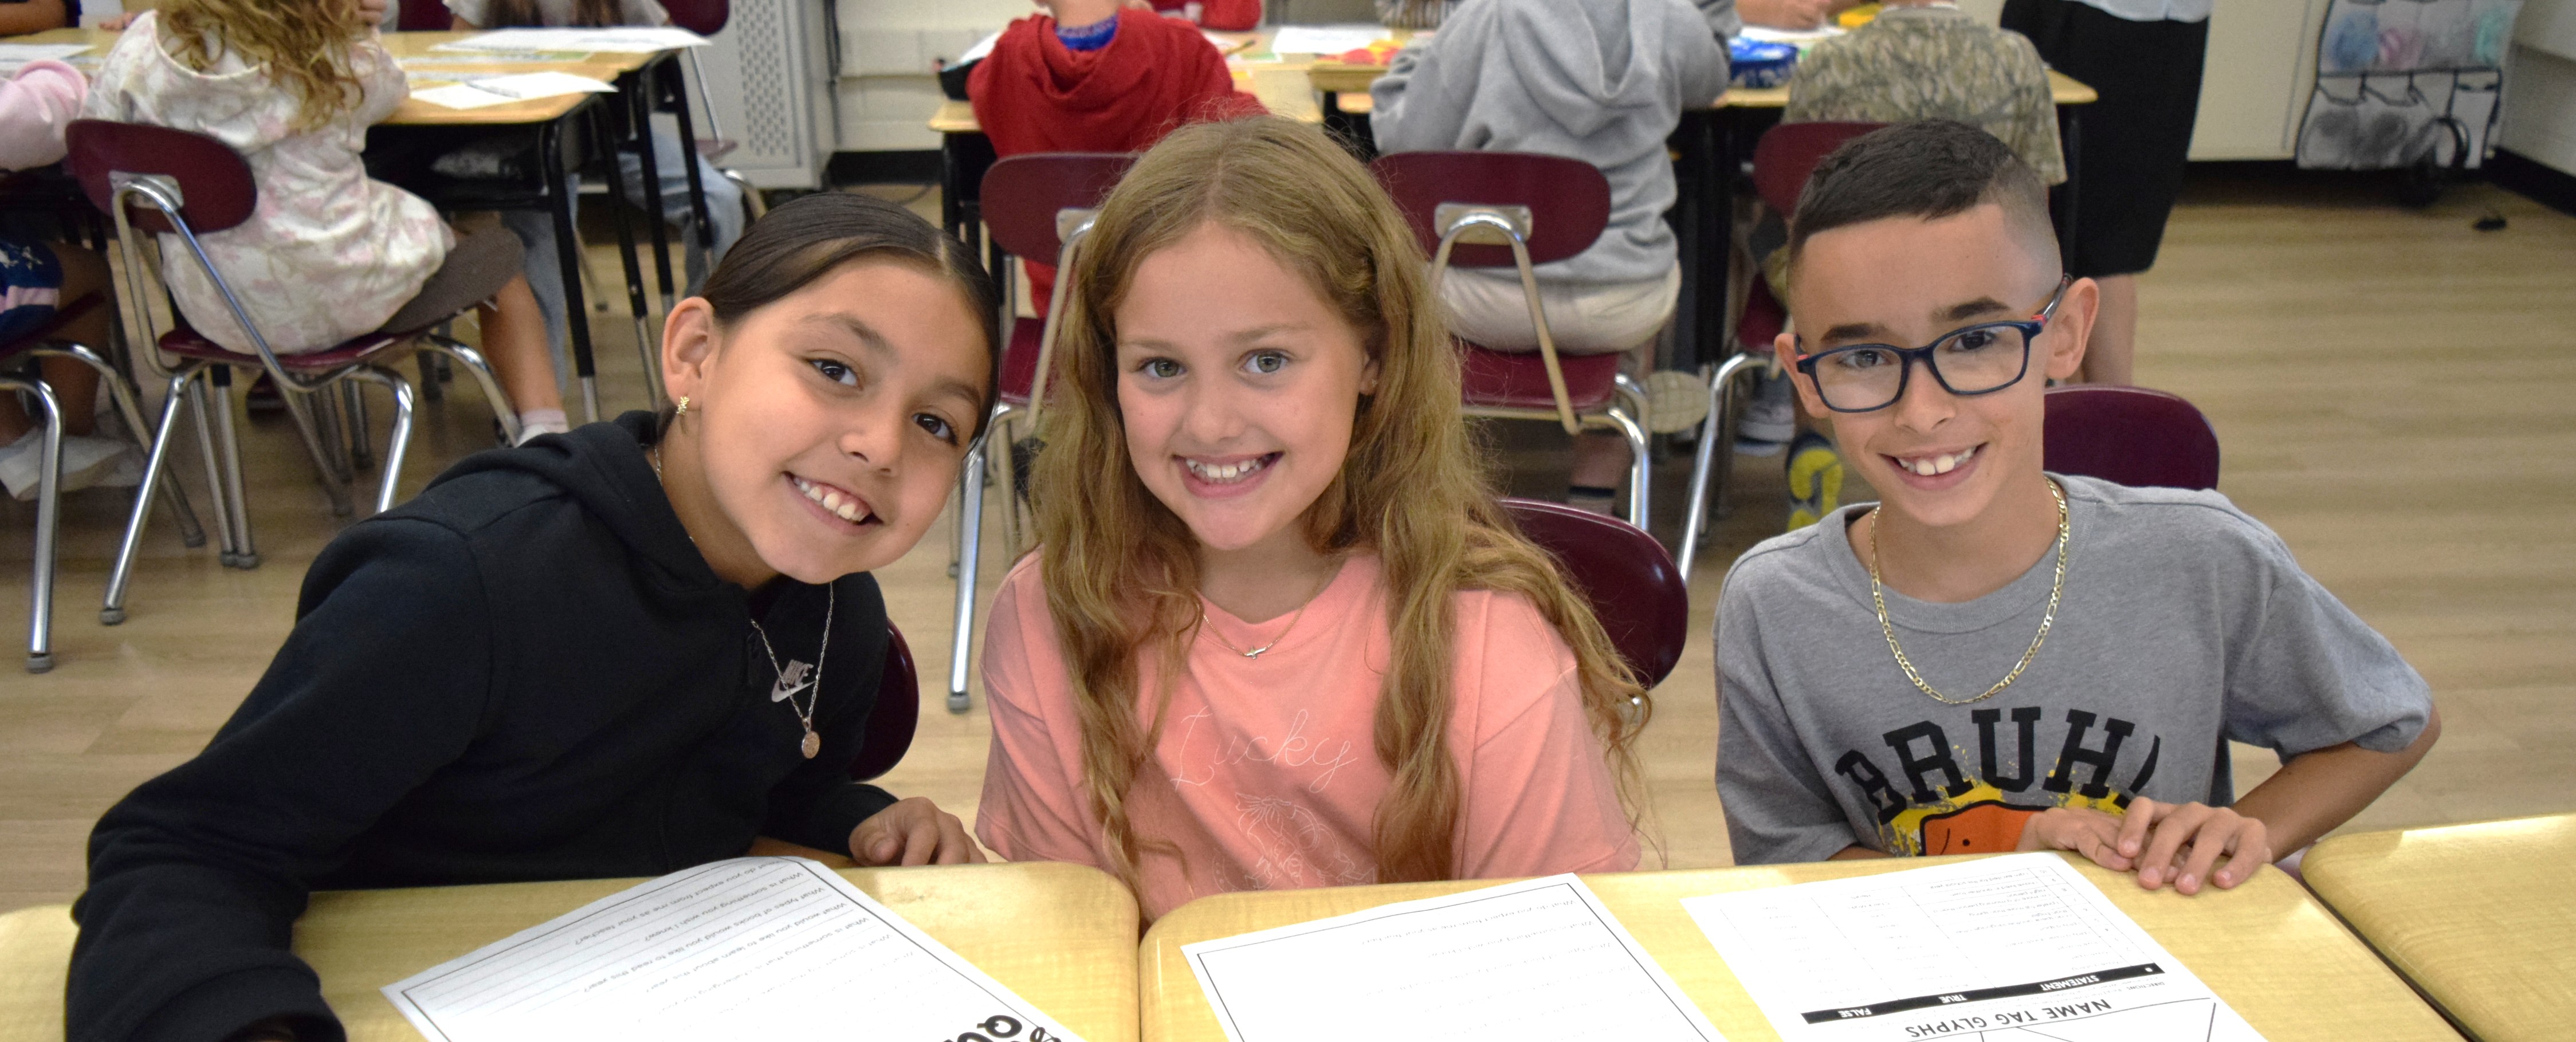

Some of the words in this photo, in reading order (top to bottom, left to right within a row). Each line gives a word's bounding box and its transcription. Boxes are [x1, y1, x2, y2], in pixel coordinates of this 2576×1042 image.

[1169, 705, 1358, 793] Lucky
[1835, 706, 2161, 824] BRUH!
[726, 872, 741, 883] you
[779, 872, 803, 884] What
[695, 880, 725, 896] expect
[800, 887, 825, 900] What
[670, 894, 693, 906] from
[720, 886, 767, 909] something
[774, 897, 799, 910] types
[639, 910, 650, 918] as
[653, 903, 669, 913] me
[702, 905, 718, 916] you
[823, 902, 847, 915] What
[618, 914, 637, 927] your
[680, 914, 700, 929] wish
[733, 911, 762, 927] books
[794, 912, 820, 927] would
[846, 917, 869, 930] What
[575, 924, 616, 946] teacher?
[645, 926, 673, 942] knew?
[705, 925, 732, 941] would
[776, 923, 793, 934] you
[686, 937, 703, 951] you
[759, 933, 775, 942] like
[785, 932, 834, 956] something
[667, 946, 685, 956] like
[721, 946, 745, 958] learn
[631, 959, 653, 972] read
[693, 957, 720, 972] about
[610, 970, 629, 980] this
[673, 971, 690, 980] this
[584, 977, 608, 993] year?
[2040, 974, 2099, 991] STATEMENT
[1938, 993, 1967, 1004] TRUE
[1837, 1007, 1872, 1019] FALSE
[2043, 998, 2111, 1019] NAME
[1995, 1010, 2037, 1024] TAG
[1905, 1017, 1987, 1037] GLYPHS
